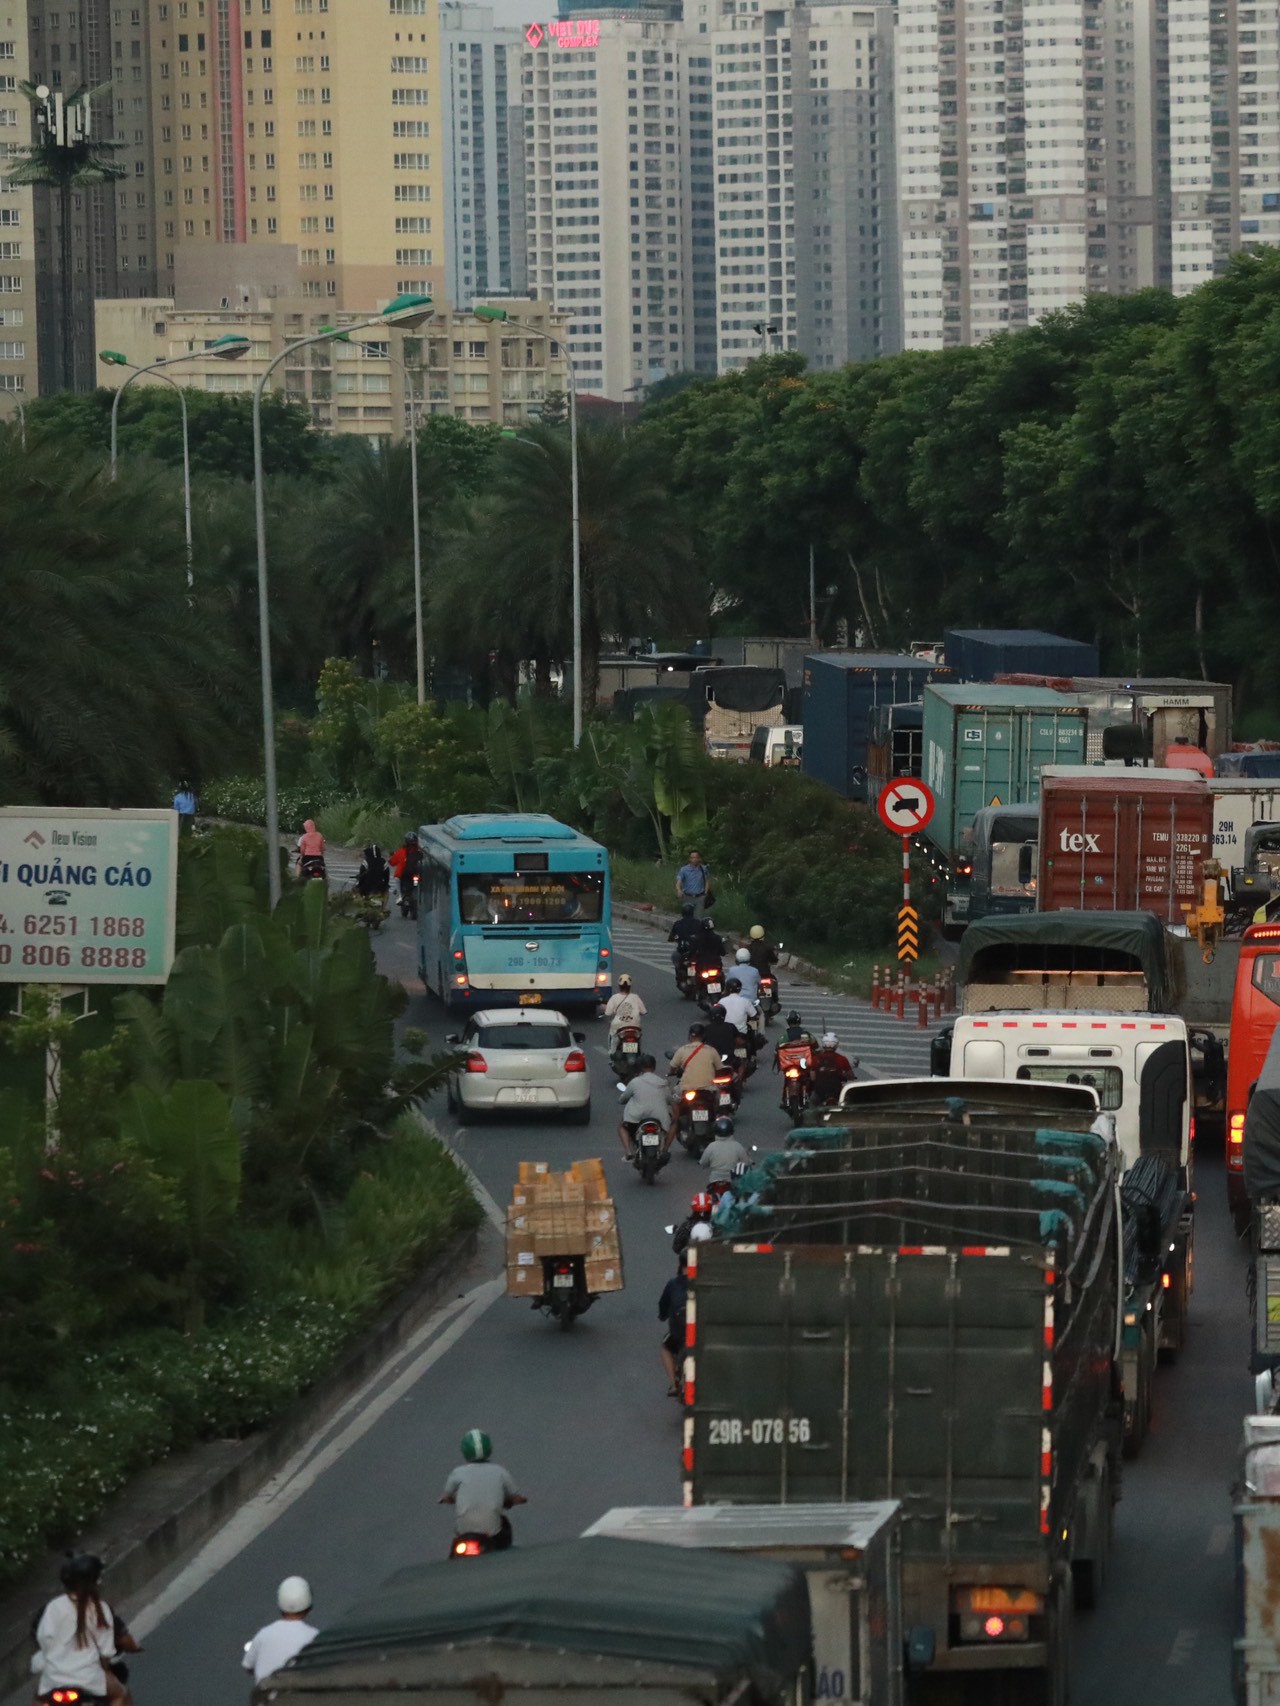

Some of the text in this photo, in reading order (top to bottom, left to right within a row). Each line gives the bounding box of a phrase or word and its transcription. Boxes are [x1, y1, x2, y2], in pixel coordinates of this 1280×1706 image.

[52, 830, 97, 846] New Vision
[1152, 832, 1169, 842] TEMU
[1176, 832, 1200, 842] 338220
[1218, 821, 1233, 832] 29H
[1059, 826, 1101, 853] tex
[17, 857, 97, 886] QUẢNG
[104, 861, 152, 887] CÁO
[24, 914, 78, 936] 6251
[90, 916, 145, 937] 1868
[22, 945, 70, 966] 806
[81, 946, 146, 968] 8888
